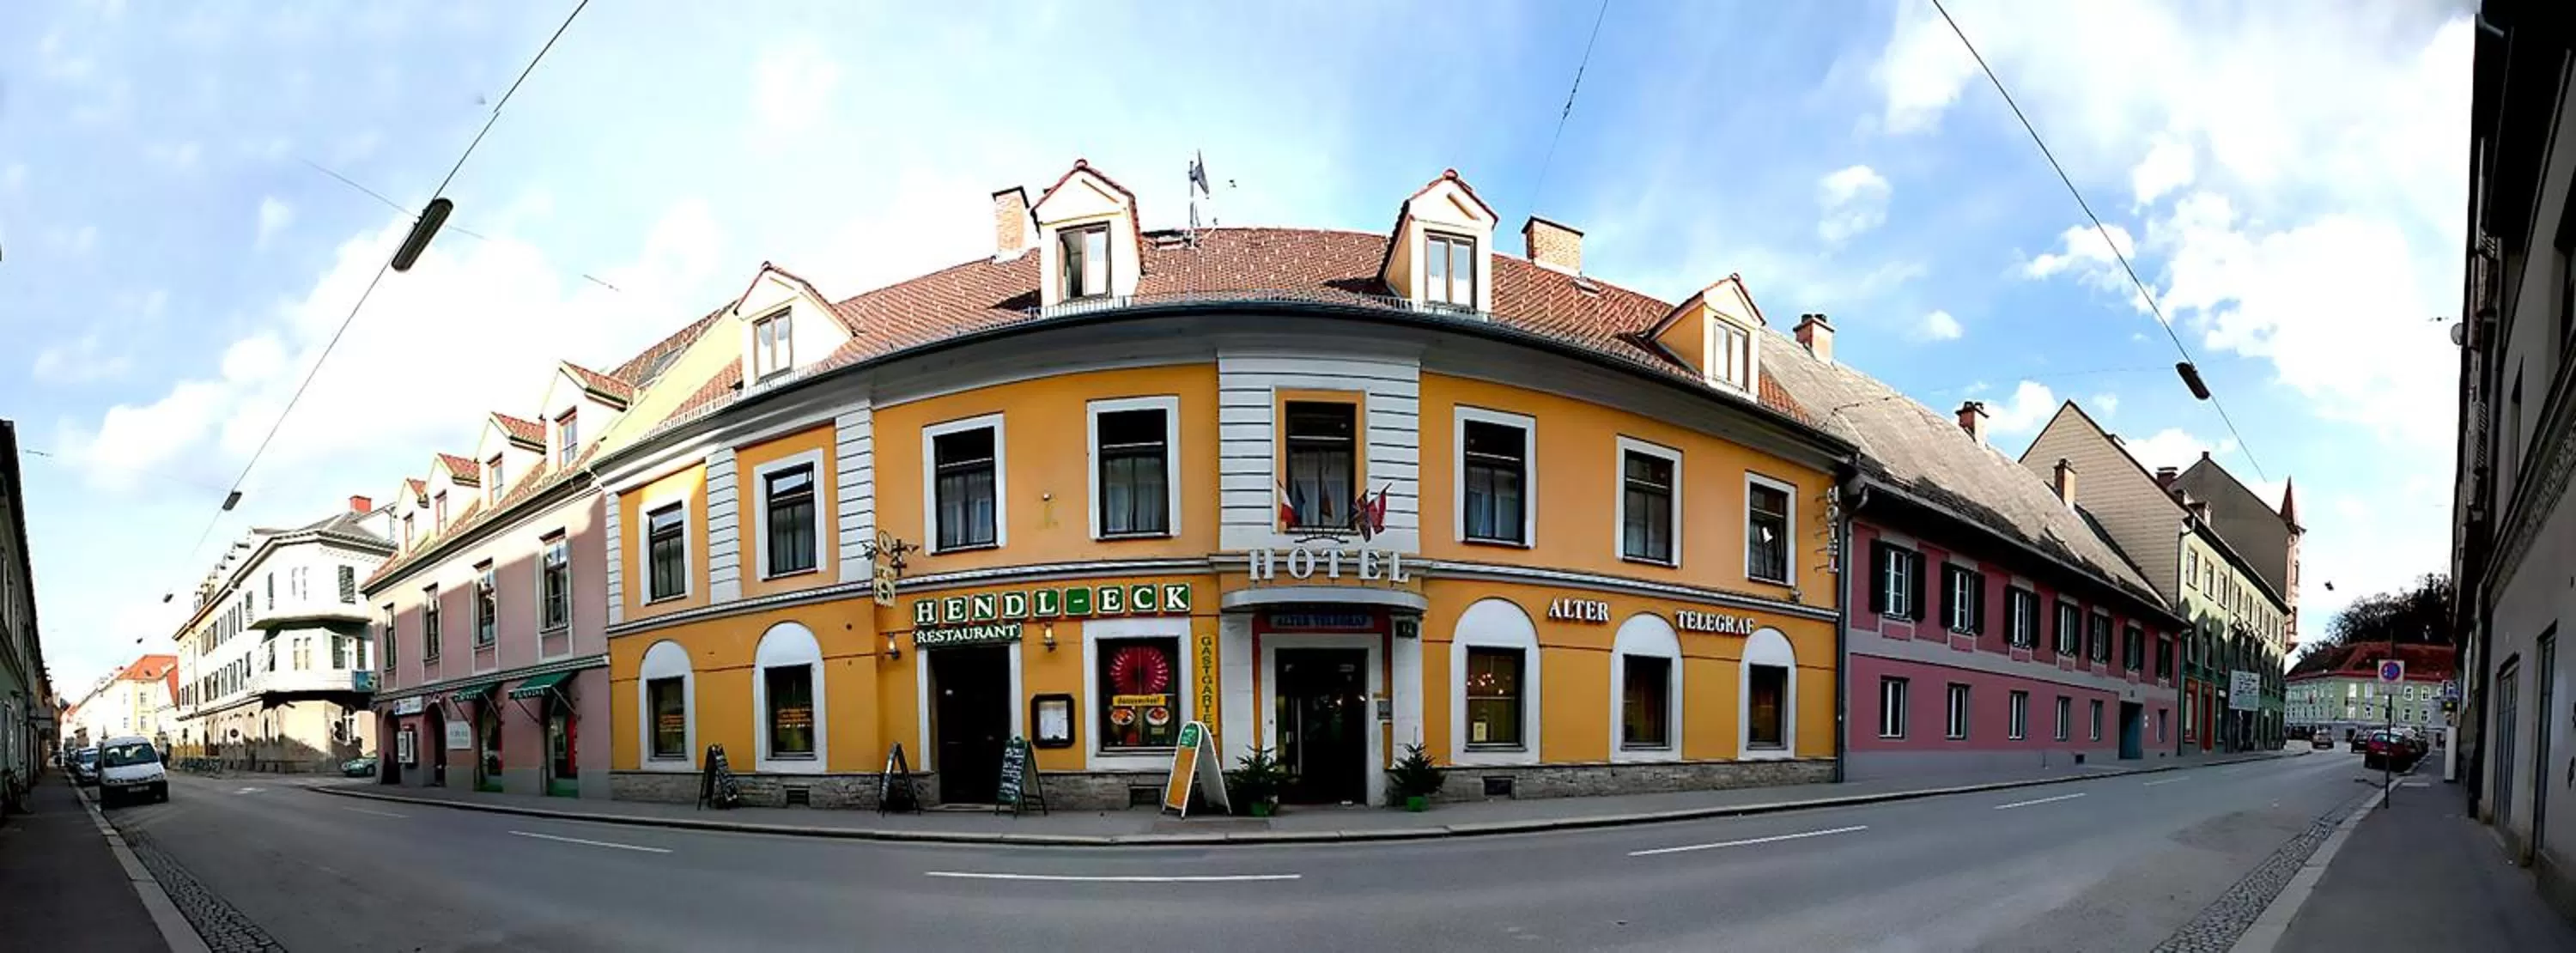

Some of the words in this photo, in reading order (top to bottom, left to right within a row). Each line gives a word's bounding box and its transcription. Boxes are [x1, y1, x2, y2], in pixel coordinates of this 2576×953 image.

[1826, 485, 1839, 574] HOTEL
[1249, 547, 1411, 583] HOTEL
[916, 586, 1187, 622] HENDL-ECK
[1547, 599, 1610, 622] ALTER
[1675, 610, 1755, 634] TELEGRAF
[916, 624, 1017, 643] RESTAURANT
[1201, 636, 1213, 733] GASTGARTEN
